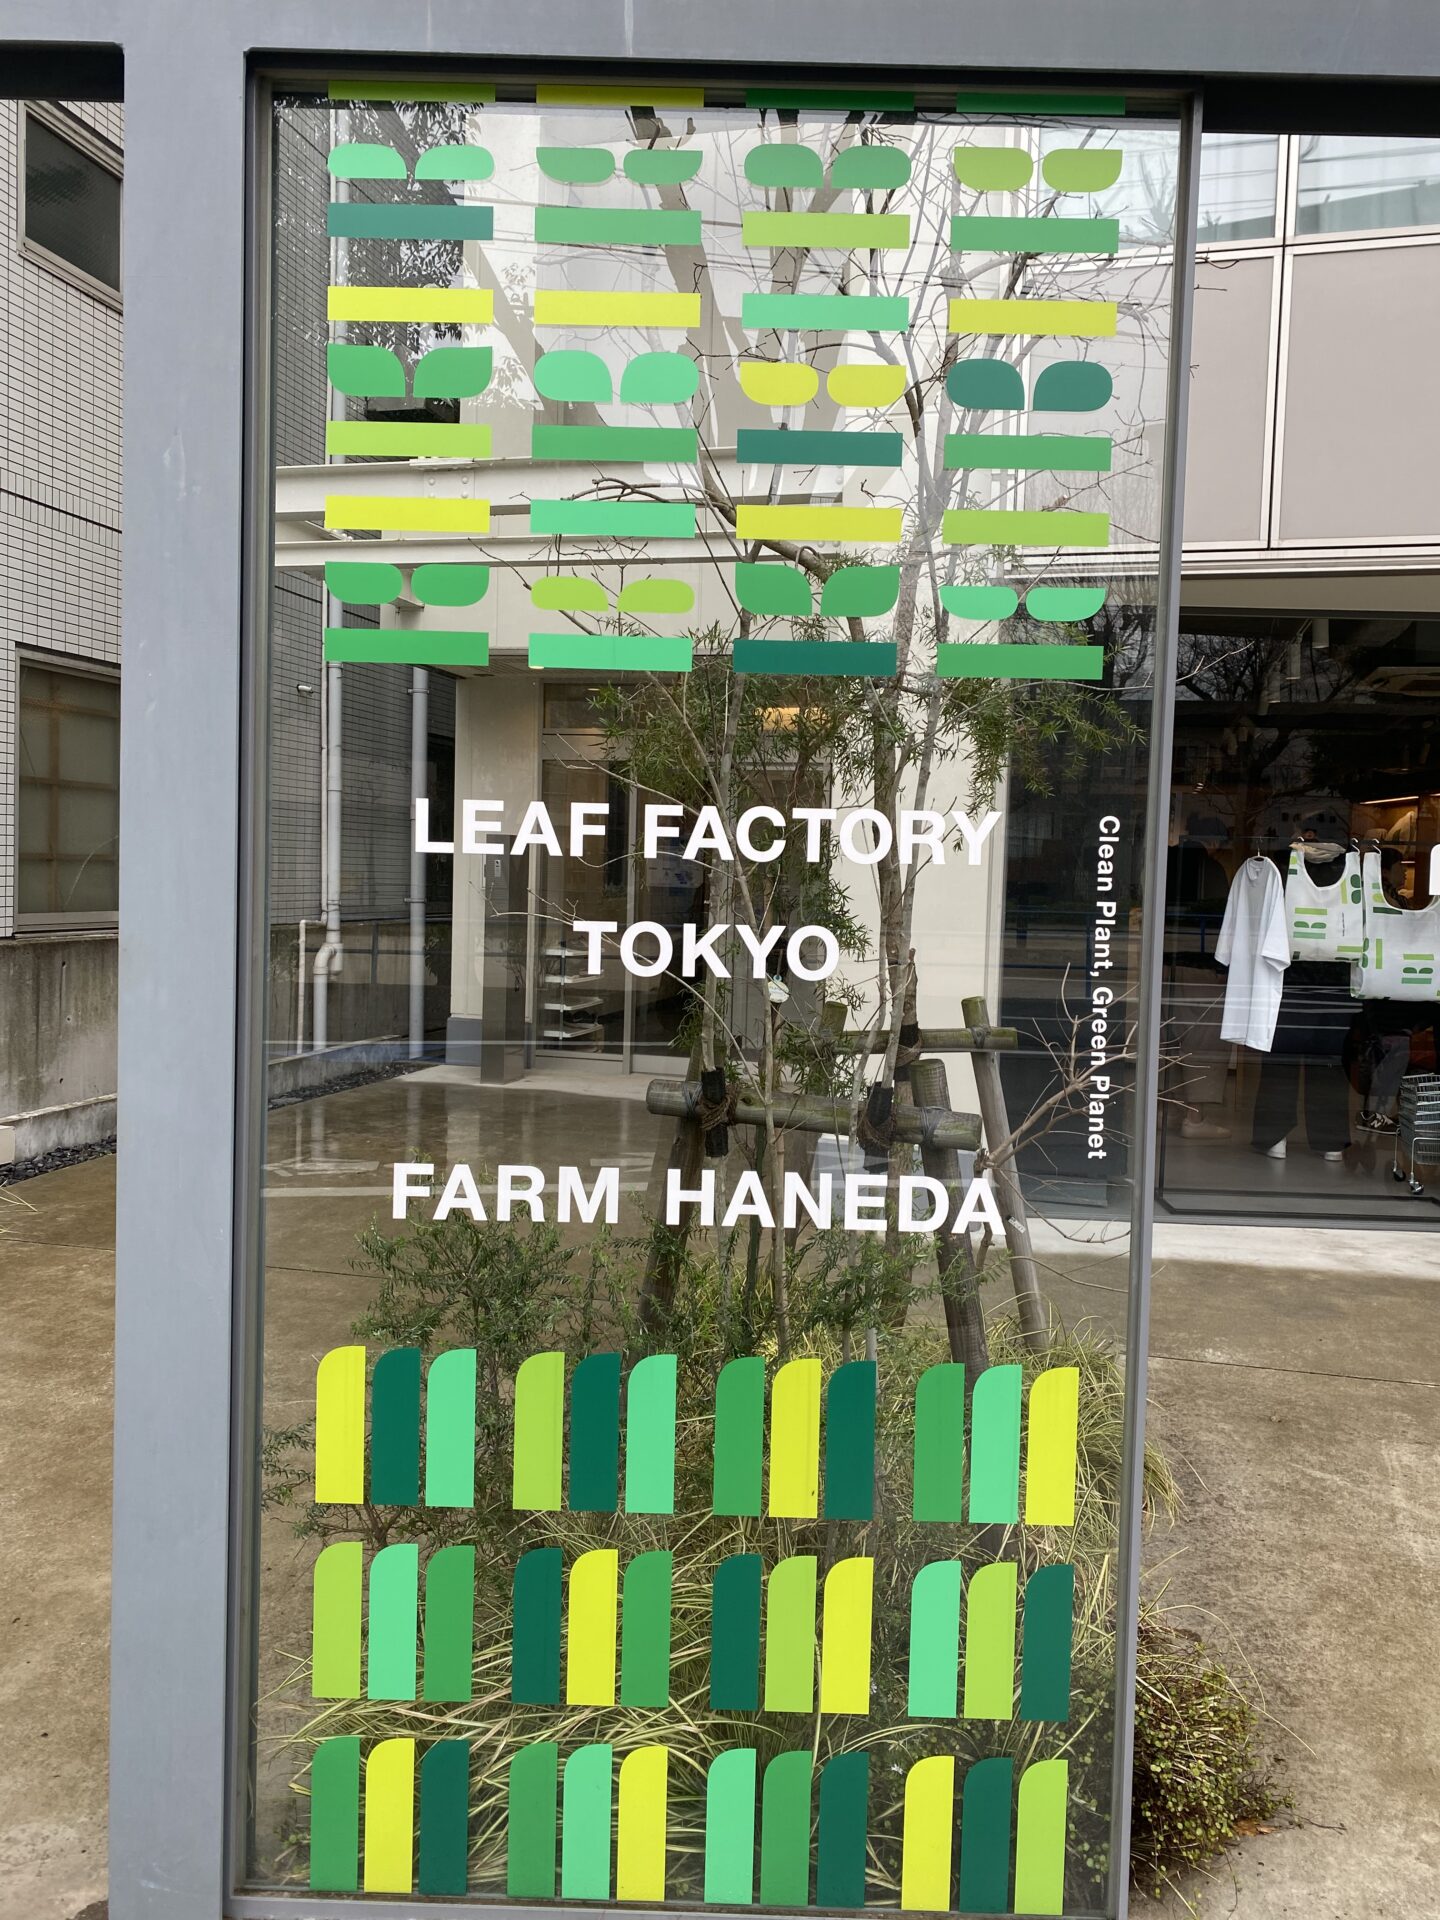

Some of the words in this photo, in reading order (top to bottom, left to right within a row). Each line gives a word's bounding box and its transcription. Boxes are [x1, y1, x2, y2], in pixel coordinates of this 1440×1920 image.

[414, 798, 609, 859] LEAF
[644, 804, 1003, 867] FACTORY
[1097, 815, 1121, 892] Clean
[572, 920, 840, 982] TOKYO
[1089, 901, 1118, 978] Plant,
[1090, 986, 1114, 1067] Green
[1087, 1075, 1111, 1160] Planet
[391, 1162, 620, 1224] FARM
[666, 1169, 1007, 1236] HANEDA
